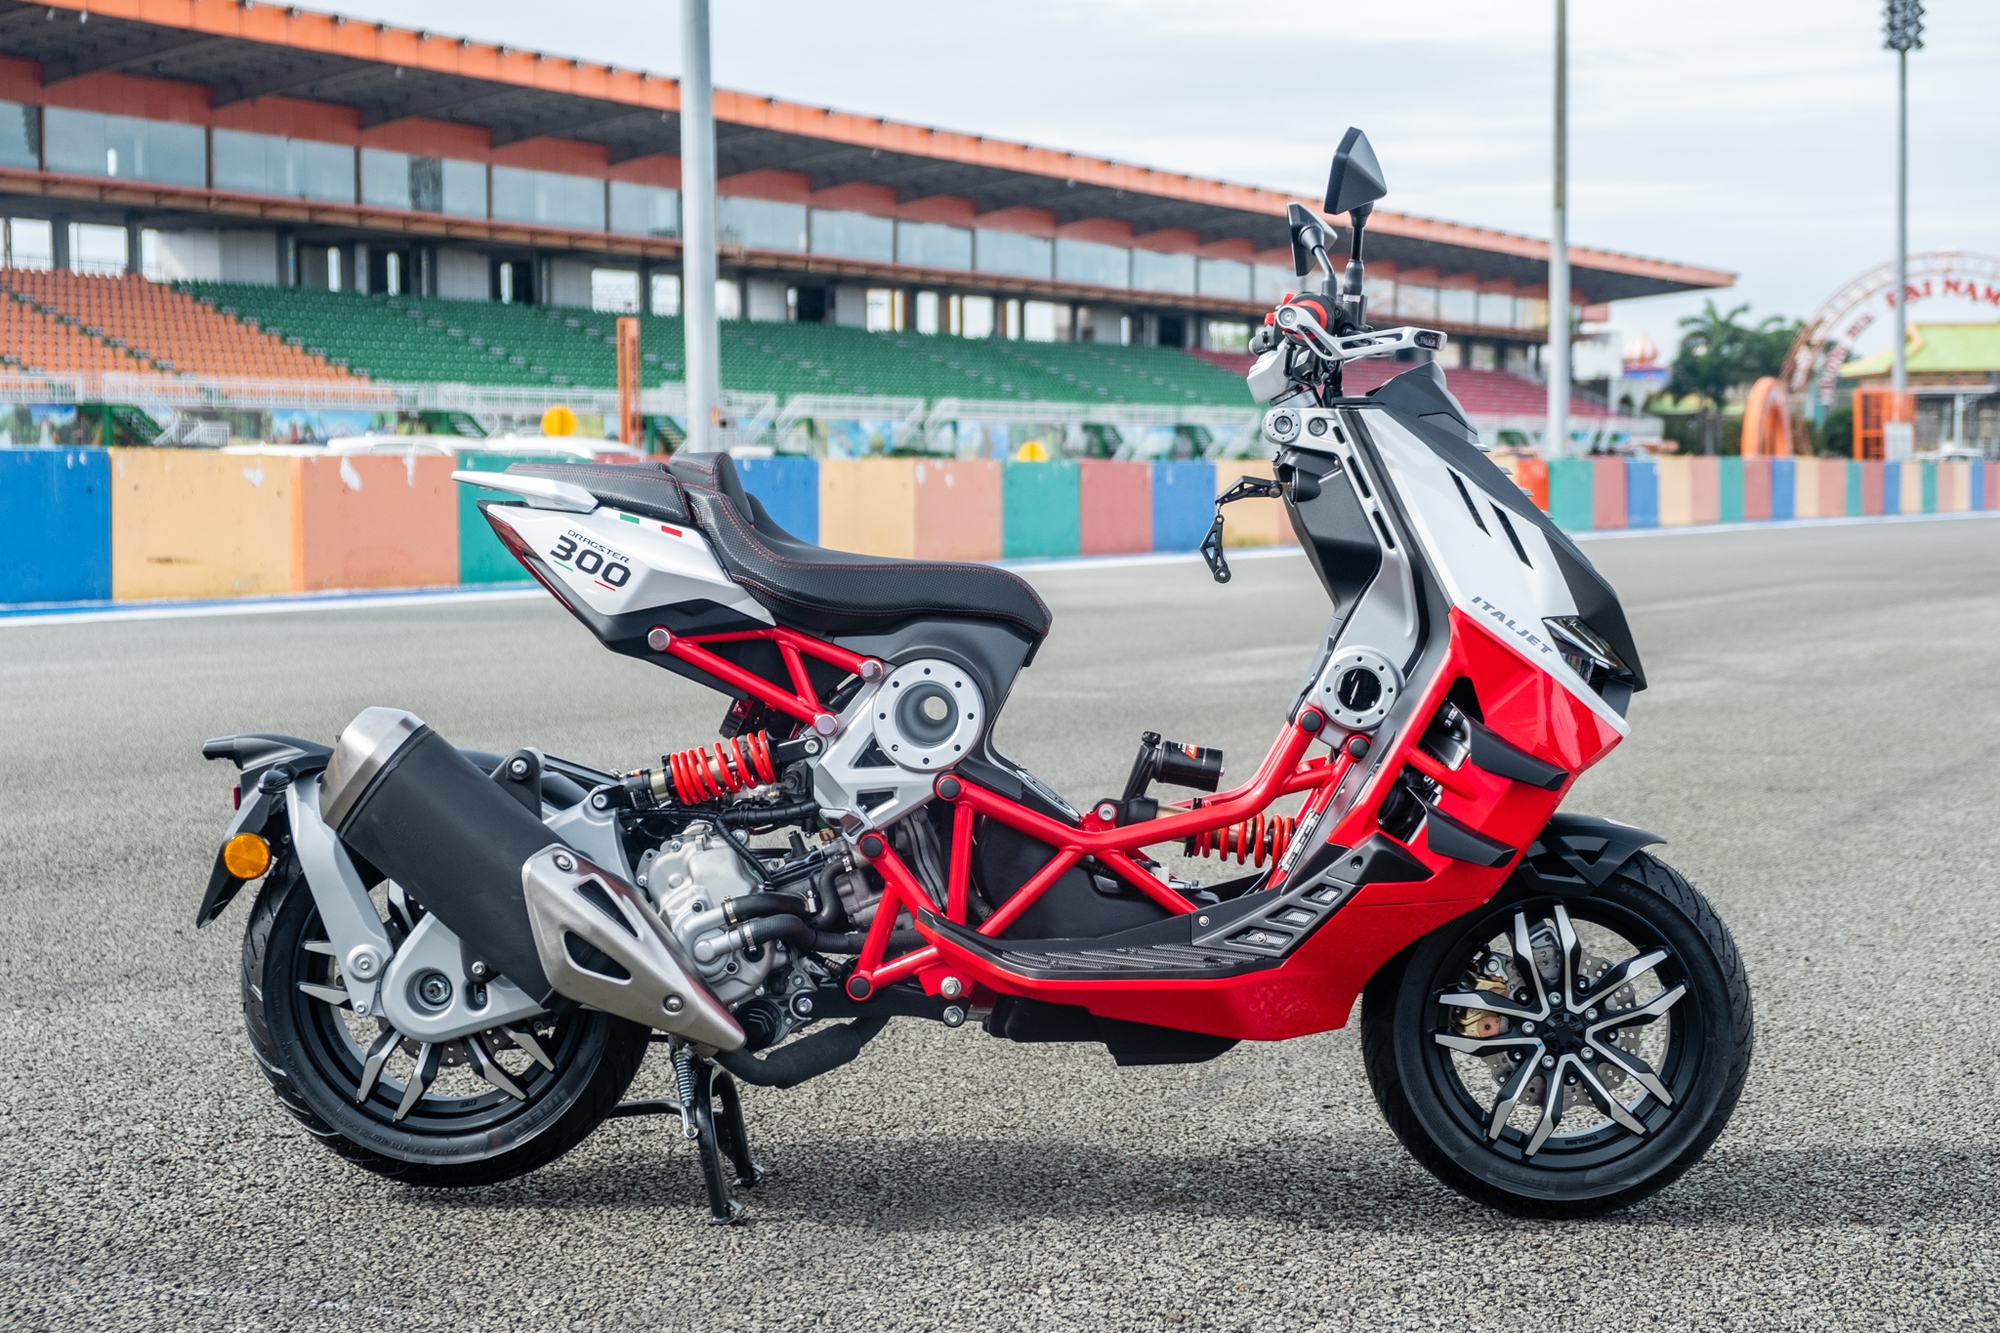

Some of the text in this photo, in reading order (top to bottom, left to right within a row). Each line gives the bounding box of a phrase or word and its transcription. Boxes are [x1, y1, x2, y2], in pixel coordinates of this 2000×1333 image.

[549, 534, 632, 587] 300
[567, 529, 630, 563] DRAGSTER
[1471, 596, 1553, 654] ITALJET
[508, 1088, 572, 1143] PIRELLI
